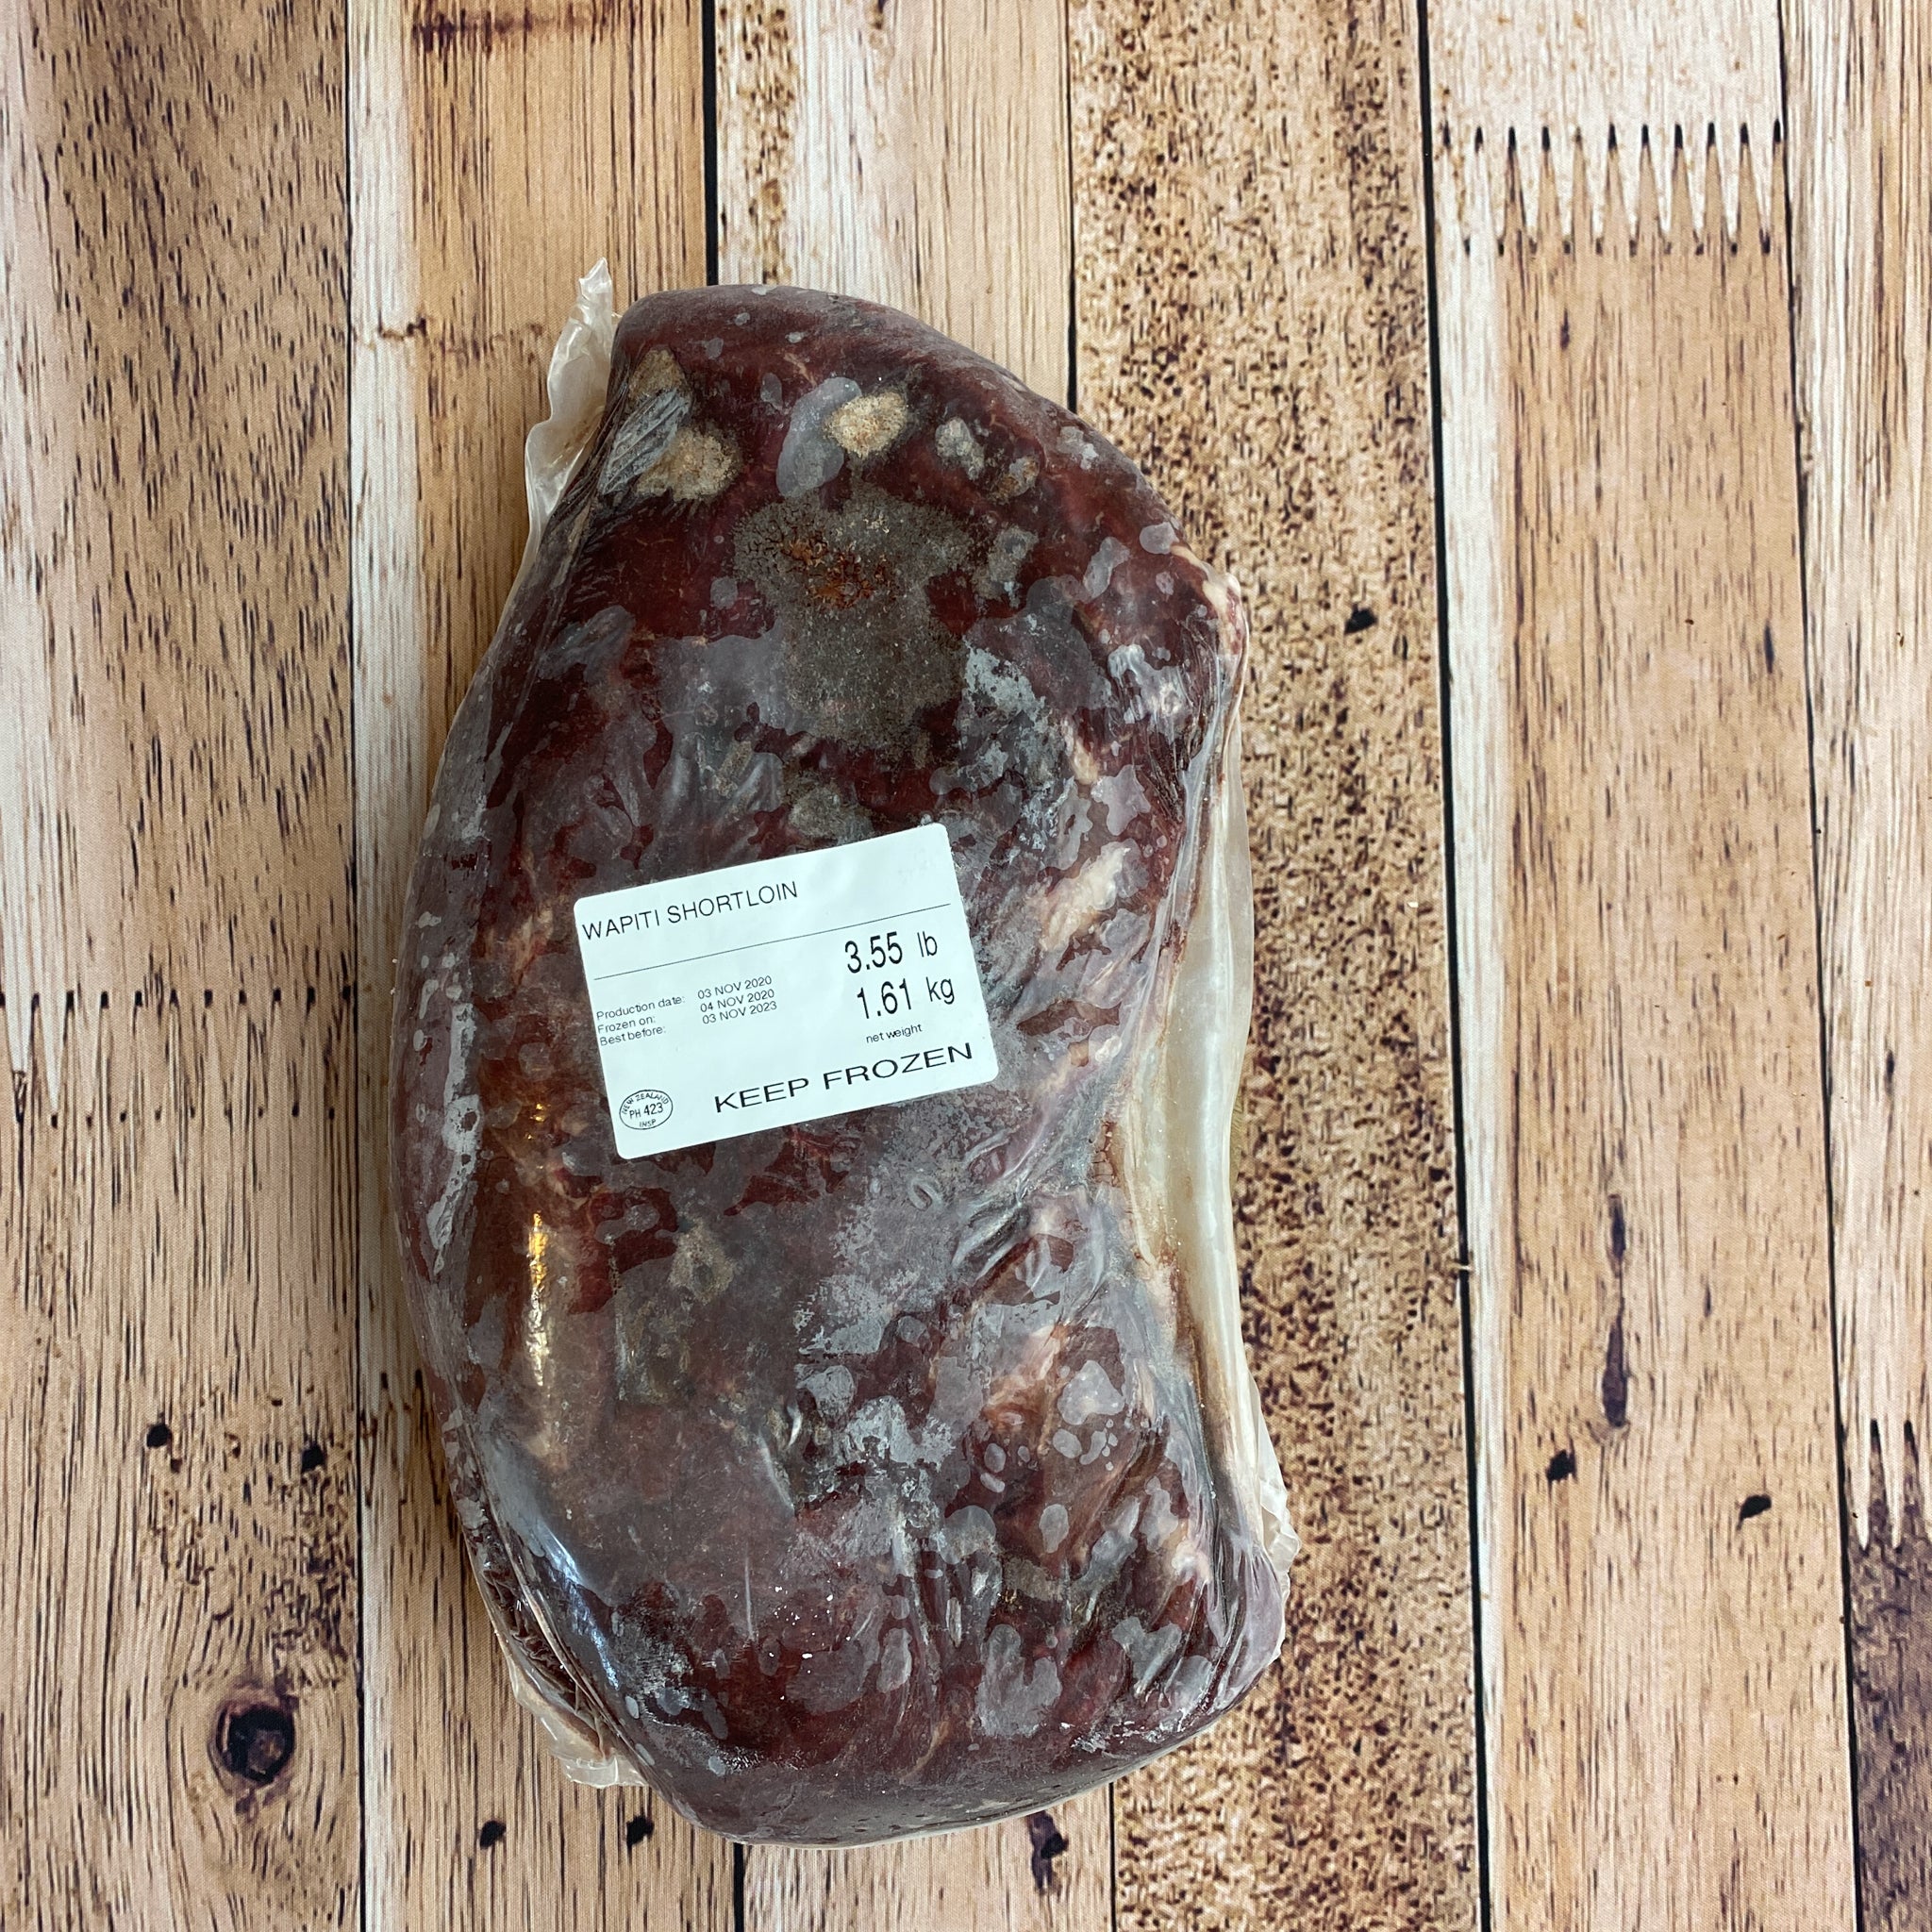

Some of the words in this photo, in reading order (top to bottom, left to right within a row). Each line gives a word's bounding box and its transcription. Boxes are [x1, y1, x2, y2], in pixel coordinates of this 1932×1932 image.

[582, 909, 660, 941] WAPITI
[667, 880, 798, 924] SHORTLOIN
[844, 931, 903, 974] 3.55
[917, 931, 938, 958] lb
[697, 989, 712, 1000] 03
[714, 982, 742, 997] NOV
[744, 975, 773, 991] 2020
[856, 978, 912, 1020] 1.61
[925, 976, 956, 1006] kg
[596, 1002, 656, 1021] Production
[658, 995, 686, 1008] date:
[700, 1002, 714, 1013] 04
[717, 995, 744, 1009] NOV
[746, 989, 774, 1004] 2020
[702, 1014, 717, 1024] 03
[720, 1008, 747, 1021] NOV
[749, 1001, 777, 1015] 2023
[597, 1018, 637, 1035] Frozen
[639, 1014, 656, 1025] on:
[599, 1033, 626, 1047] Best
[628, 1025, 667, 1041] before:
[866, 1032, 883, 1044] net
[886, 1024, 923, 1041] weight
[714, 1078, 809, 1113] KEEP
[823, 1042, 973, 1090] FROZEN
[622, 1097, 634, 1115] NEW
[629, 1108, 641, 1120] PH
[643, 1102, 664, 1115] 423
